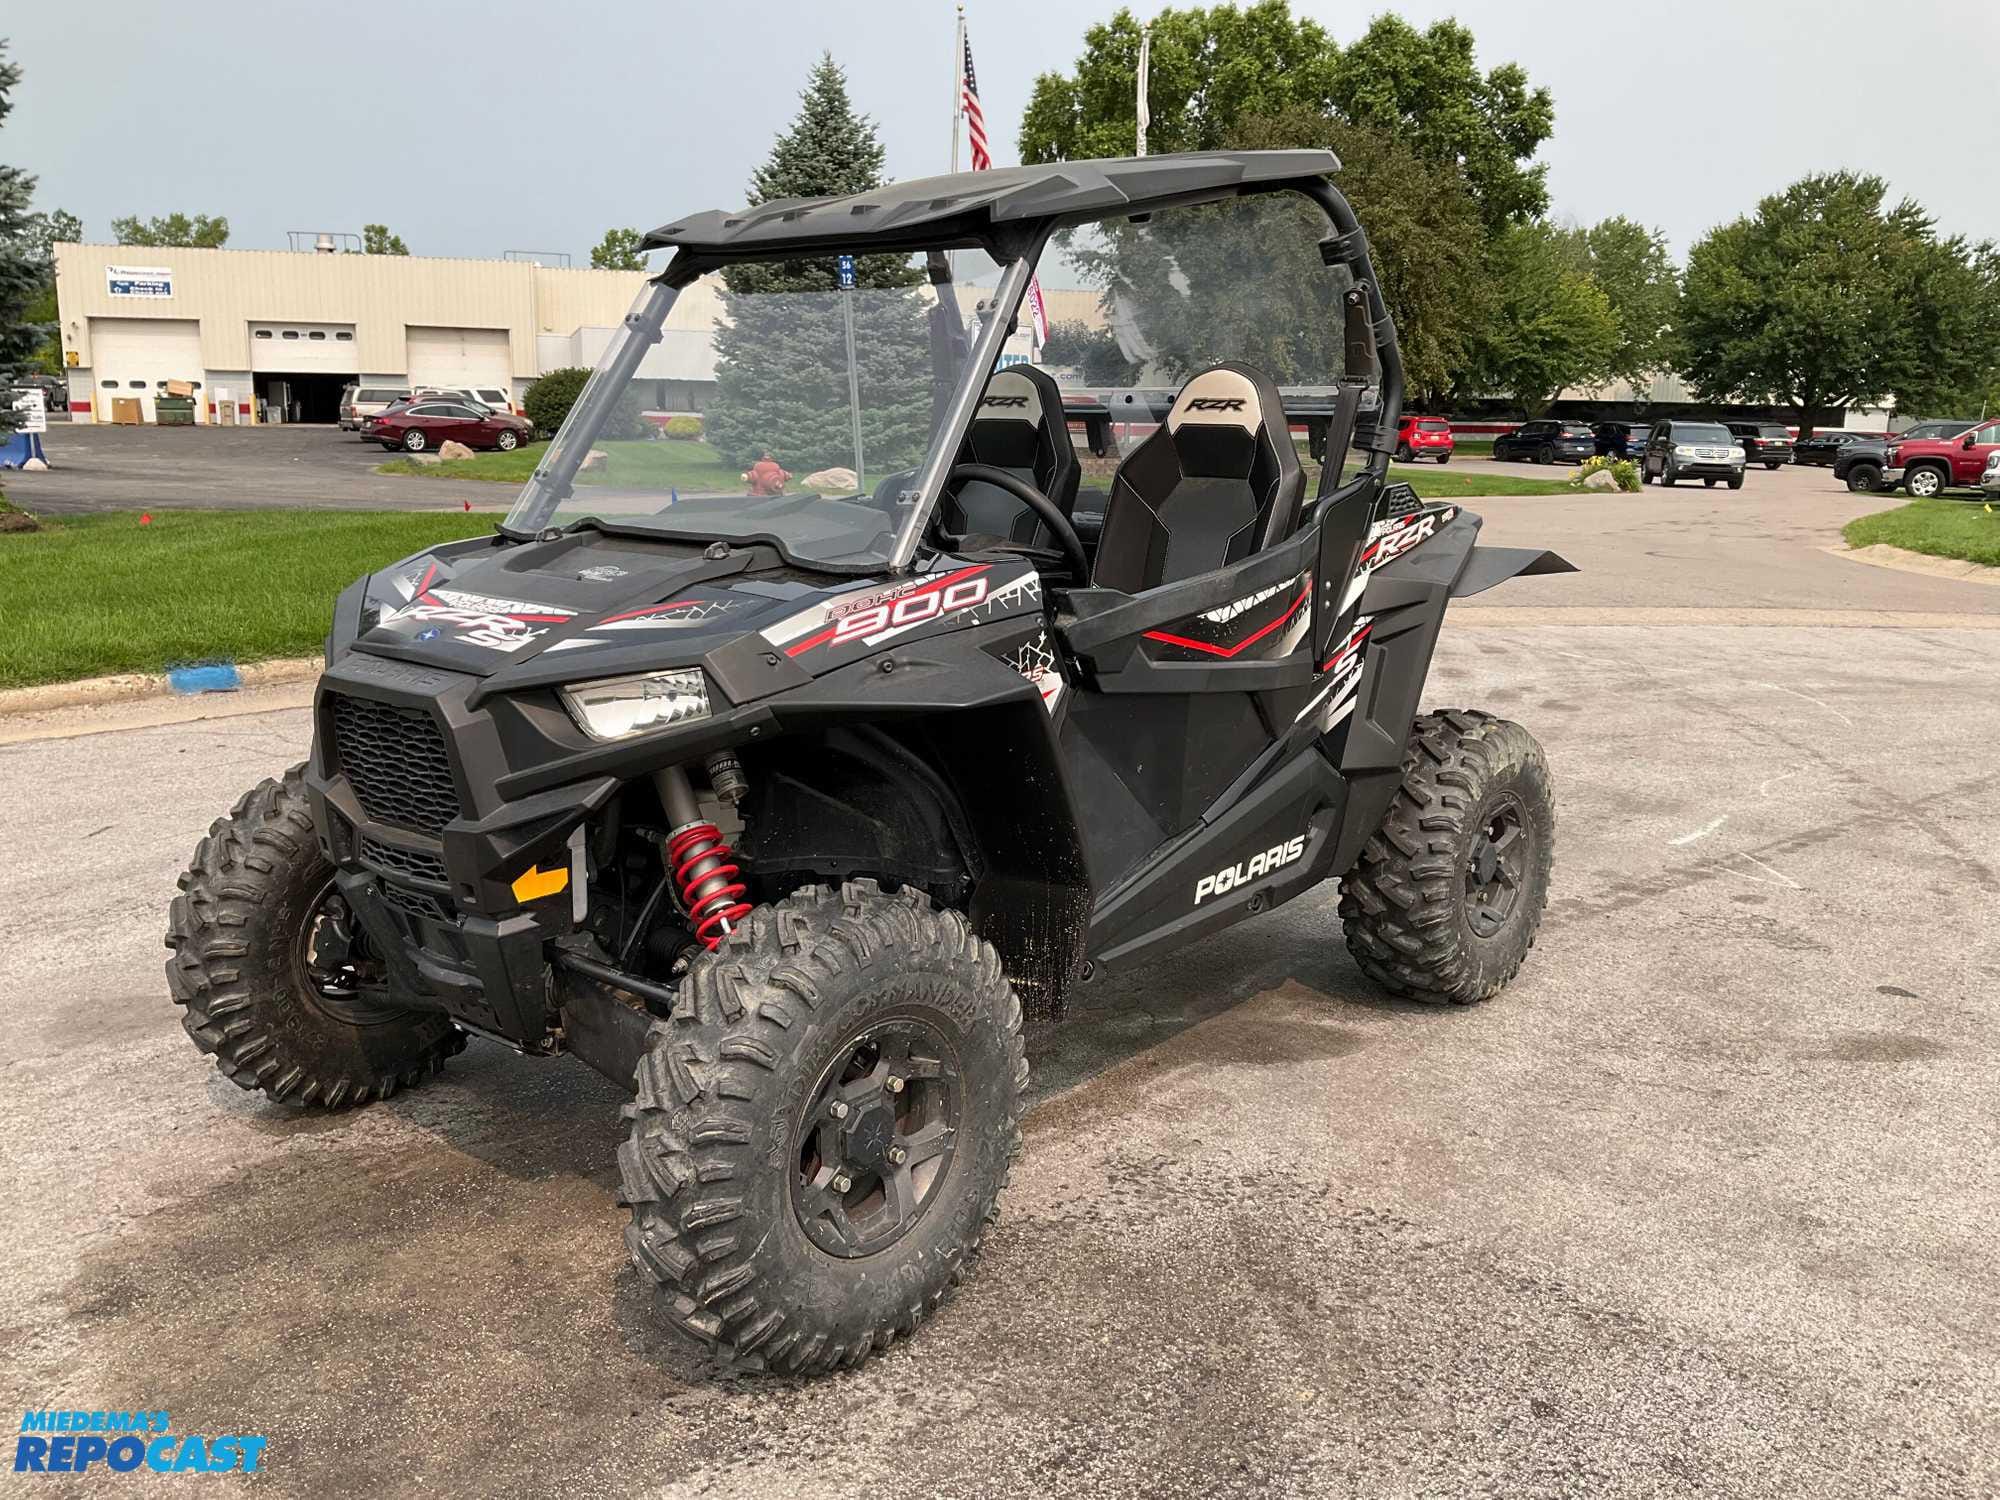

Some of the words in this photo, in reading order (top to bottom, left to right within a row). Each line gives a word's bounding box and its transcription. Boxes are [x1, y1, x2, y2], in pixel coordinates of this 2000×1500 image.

[841, 273, 852, 284] 12
[984, 396, 1029, 408] RZR
[1184, 398, 1247, 412] RZR
[1374, 514, 1435, 564] RZR
[381, 605, 526, 634] RZR
[824, 580, 918, 624] DOHC
[829, 577, 989, 648] 900
[1194, 834, 1305, 905] POLARIS
